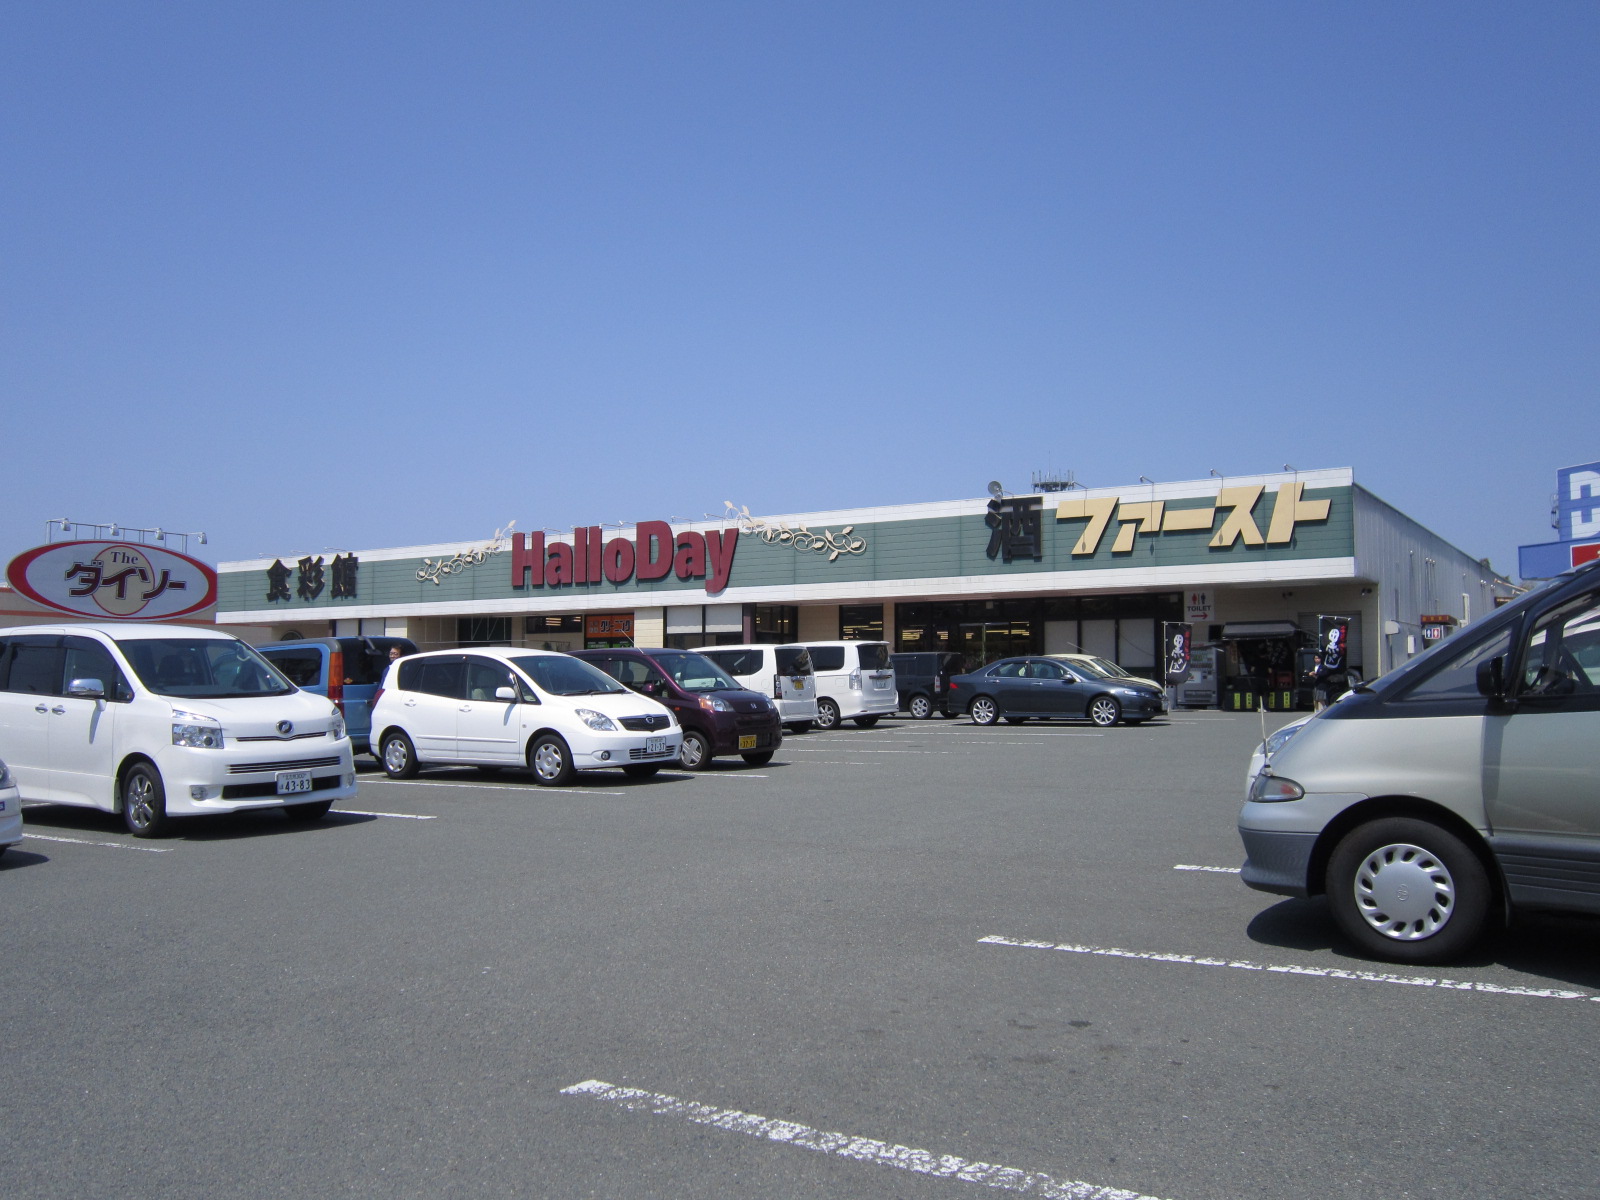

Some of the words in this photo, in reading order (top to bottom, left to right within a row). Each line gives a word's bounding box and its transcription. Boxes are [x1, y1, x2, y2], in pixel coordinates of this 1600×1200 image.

[111, 551, 139, 565] The
[512, 520, 739, 593] HalloDay
[64, 560, 187, 601] ダイソー
[266, 552, 359, 603] 食彩館
[285, 779, 310, 791] 43-83
